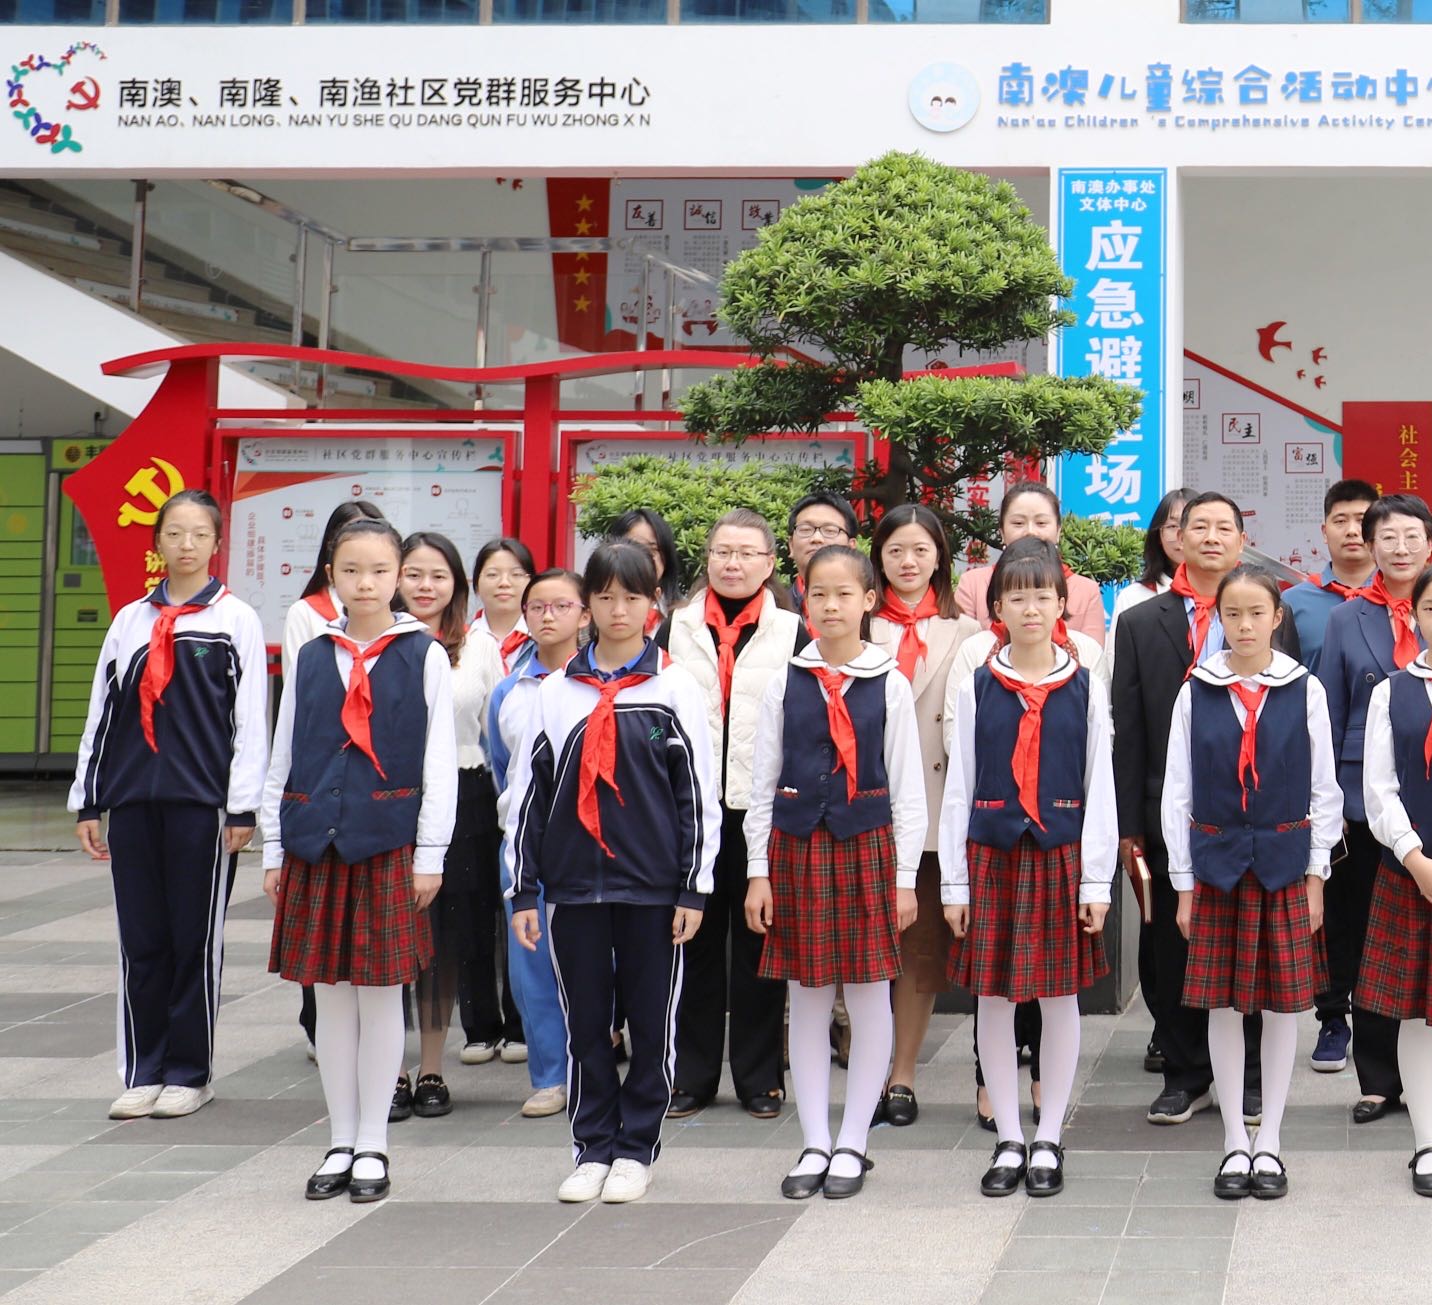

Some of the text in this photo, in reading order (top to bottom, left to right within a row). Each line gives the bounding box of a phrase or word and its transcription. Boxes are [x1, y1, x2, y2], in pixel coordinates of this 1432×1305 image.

[118, 76, 651, 109] 南澳、南隆、南渔社区党群服务中心
[118, 114, 151, 128] NAN
[193, 114, 225, 128] NAN
[289, 114, 321, 128] NAN
[327, 114, 348, 128] YU
[353, 114, 384, 128] SHE
[389, 114, 412, 128] QU
[417, 114, 462, 128] DANG
[467, 114, 501, 128] QUN
[507, 114, 526, 128] FU
[532, 114, 557, 128] WU
[562, 114, 619, 128] ZHONG
[1064, 115, 1139, 128] Children
[1175, 115, 1310, 131] Comprehensive
[1318, 115, 1395, 131] Activity
[1071, 180, 1156, 195] 南澳办事处
[1080, 197, 1148, 212] 文体中心
[1085, 219, 1144, 528] 应急避场
[1228, 417, 1256, 438] 民主
